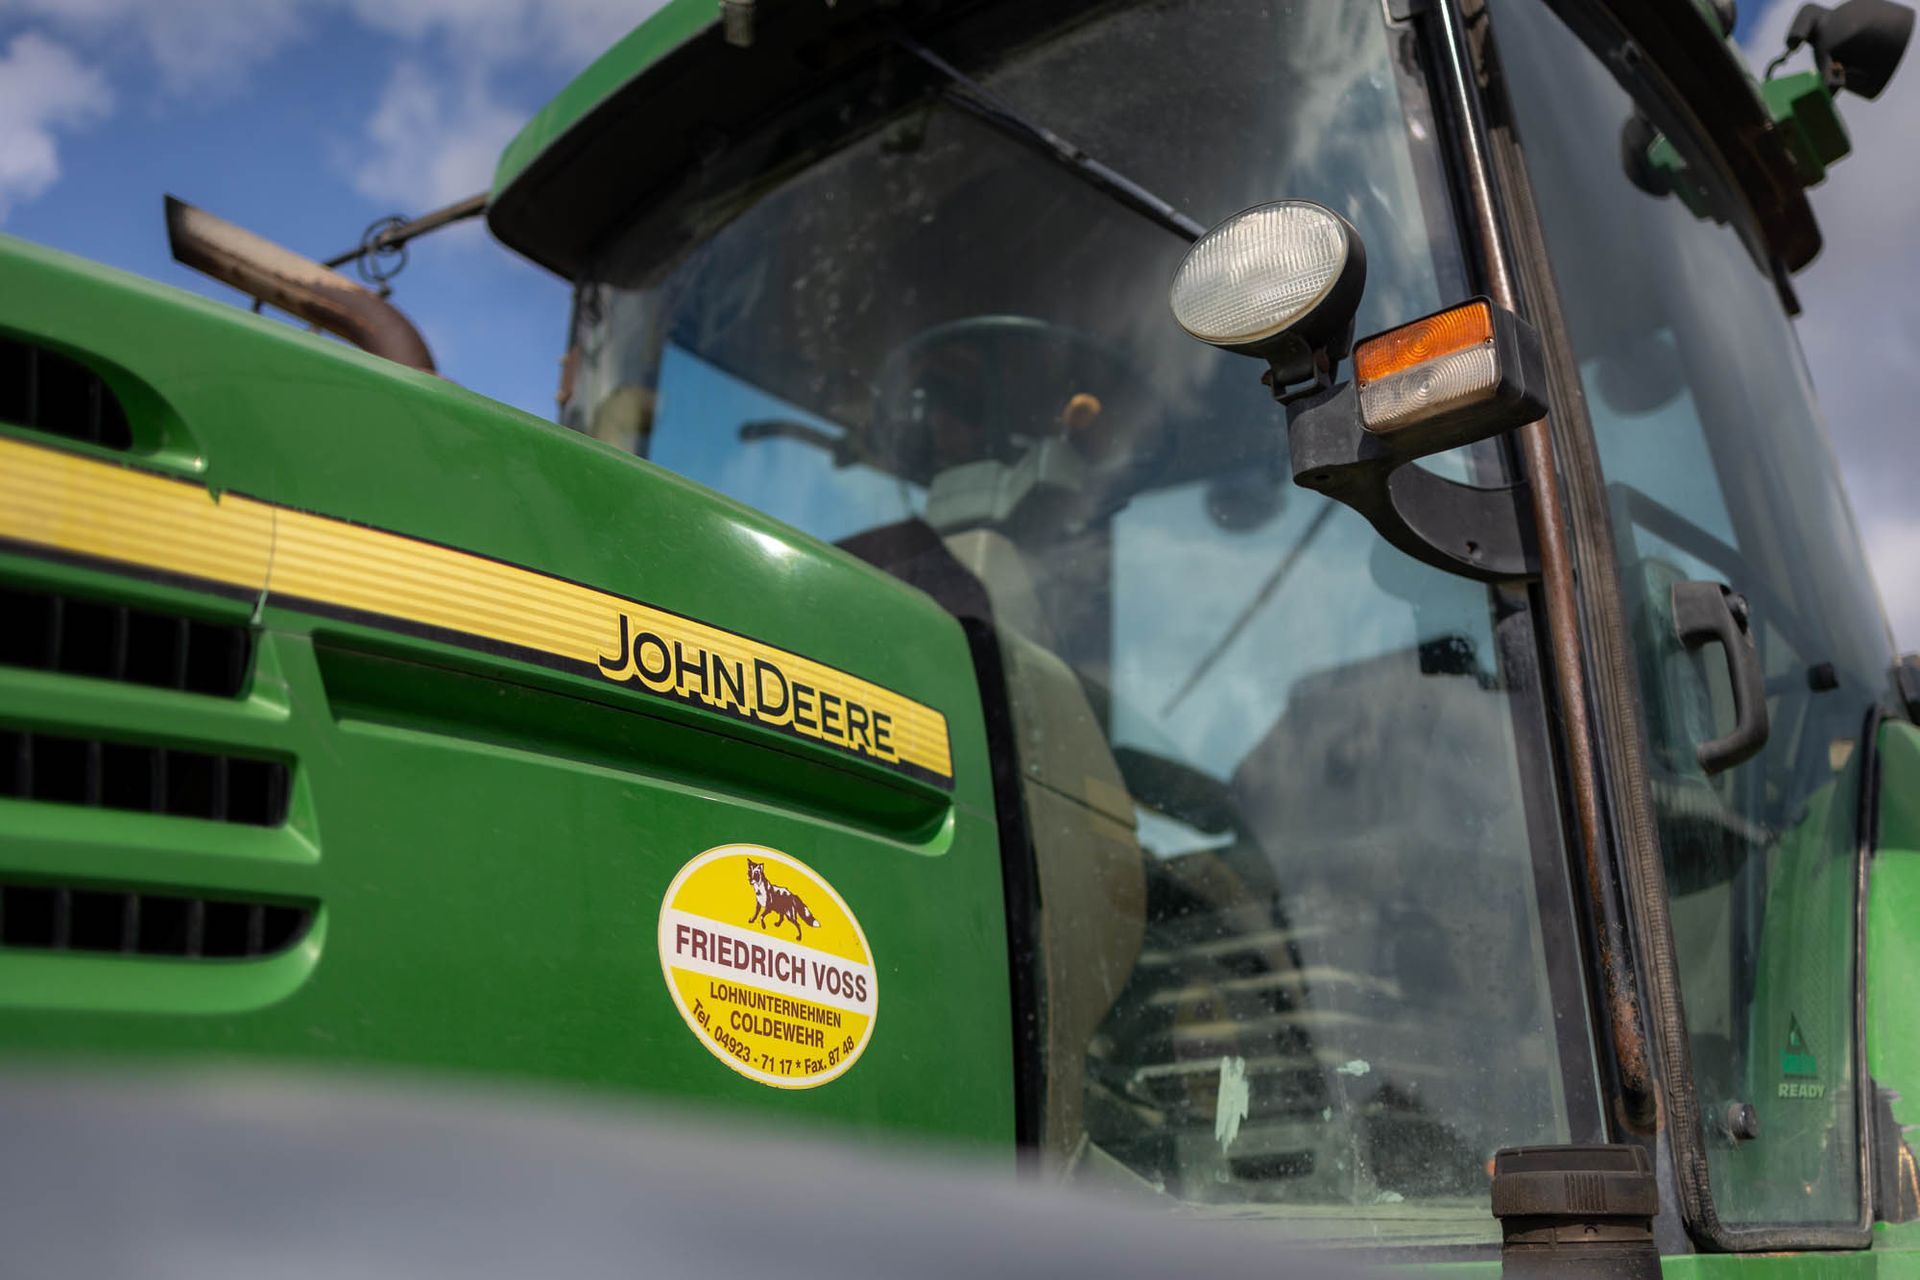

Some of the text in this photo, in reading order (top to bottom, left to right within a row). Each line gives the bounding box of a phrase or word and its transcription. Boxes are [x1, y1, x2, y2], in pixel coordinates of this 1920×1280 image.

[599, 613, 895, 755] JOHN DEERE
[676, 924, 868, 1003] FRIEDRICH VOSS
[710, 981, 842, 1029] LOHNUNTERNEHMEN
[730, 1010, 825, 1049] COLDEWEHR
[692, 998, 711, 1033] Tel.
[714, 1025, 751, 1063] 04923
[761, 1054, 775, 1073] 71
[780, 1059, 793, 1075] 17
[805, 1058, 828, 1075] Fax.
[828, 1047, 841, 1067] 87
[842, 1035, 855, 1056] 48
[1777, 1082, 1826, 1099] READY
